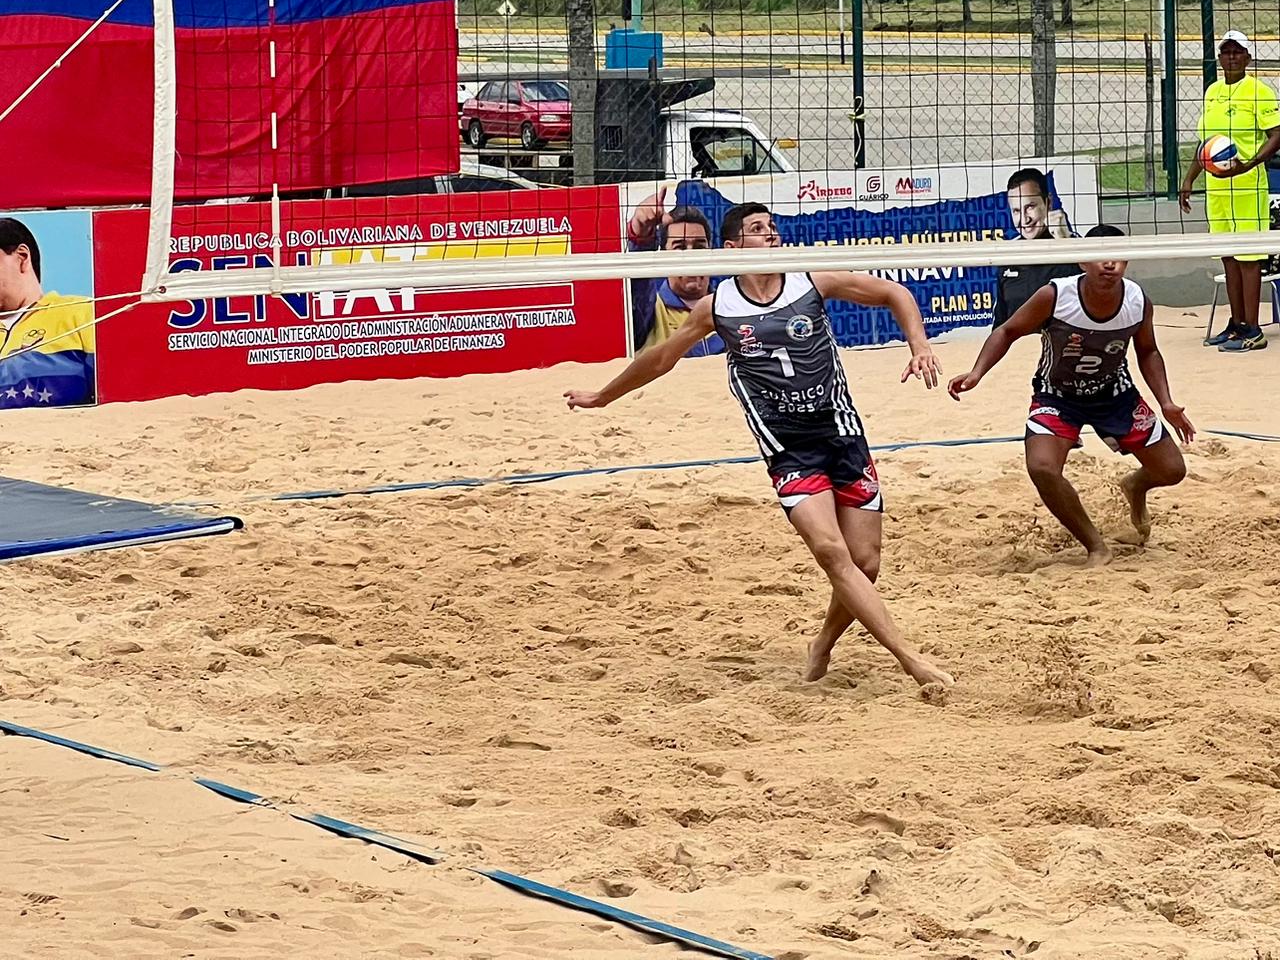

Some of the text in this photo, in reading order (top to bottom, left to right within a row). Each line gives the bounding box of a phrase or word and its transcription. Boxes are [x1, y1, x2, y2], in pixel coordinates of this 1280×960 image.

[859, 192, 889, 201] GUÁRICO
[169, 216, 572, 253] REPUBLICA BOLIVARIANA DE VENEZUELA
[931, 295, 967, 313] PLAN
[972, 292, 992, 310] 39
[943, 315, 951, 323] EN
[952, 312, 993, 322] REVOLUCIÓN
[168, 309, 576, 350] SERVICIO NACIONAL INTEGRADO DE ADMINISTRACIÓN ADUANERA Y TRIBUTARIA
[248, 333, 505, 364] MINISTERIO DEL PODER POPULAR DE FINANZAS
[770, 347, 796, 377] 1
[1075, 355, 1102, 374] 2
[778, 402, 815, 412] 2025
